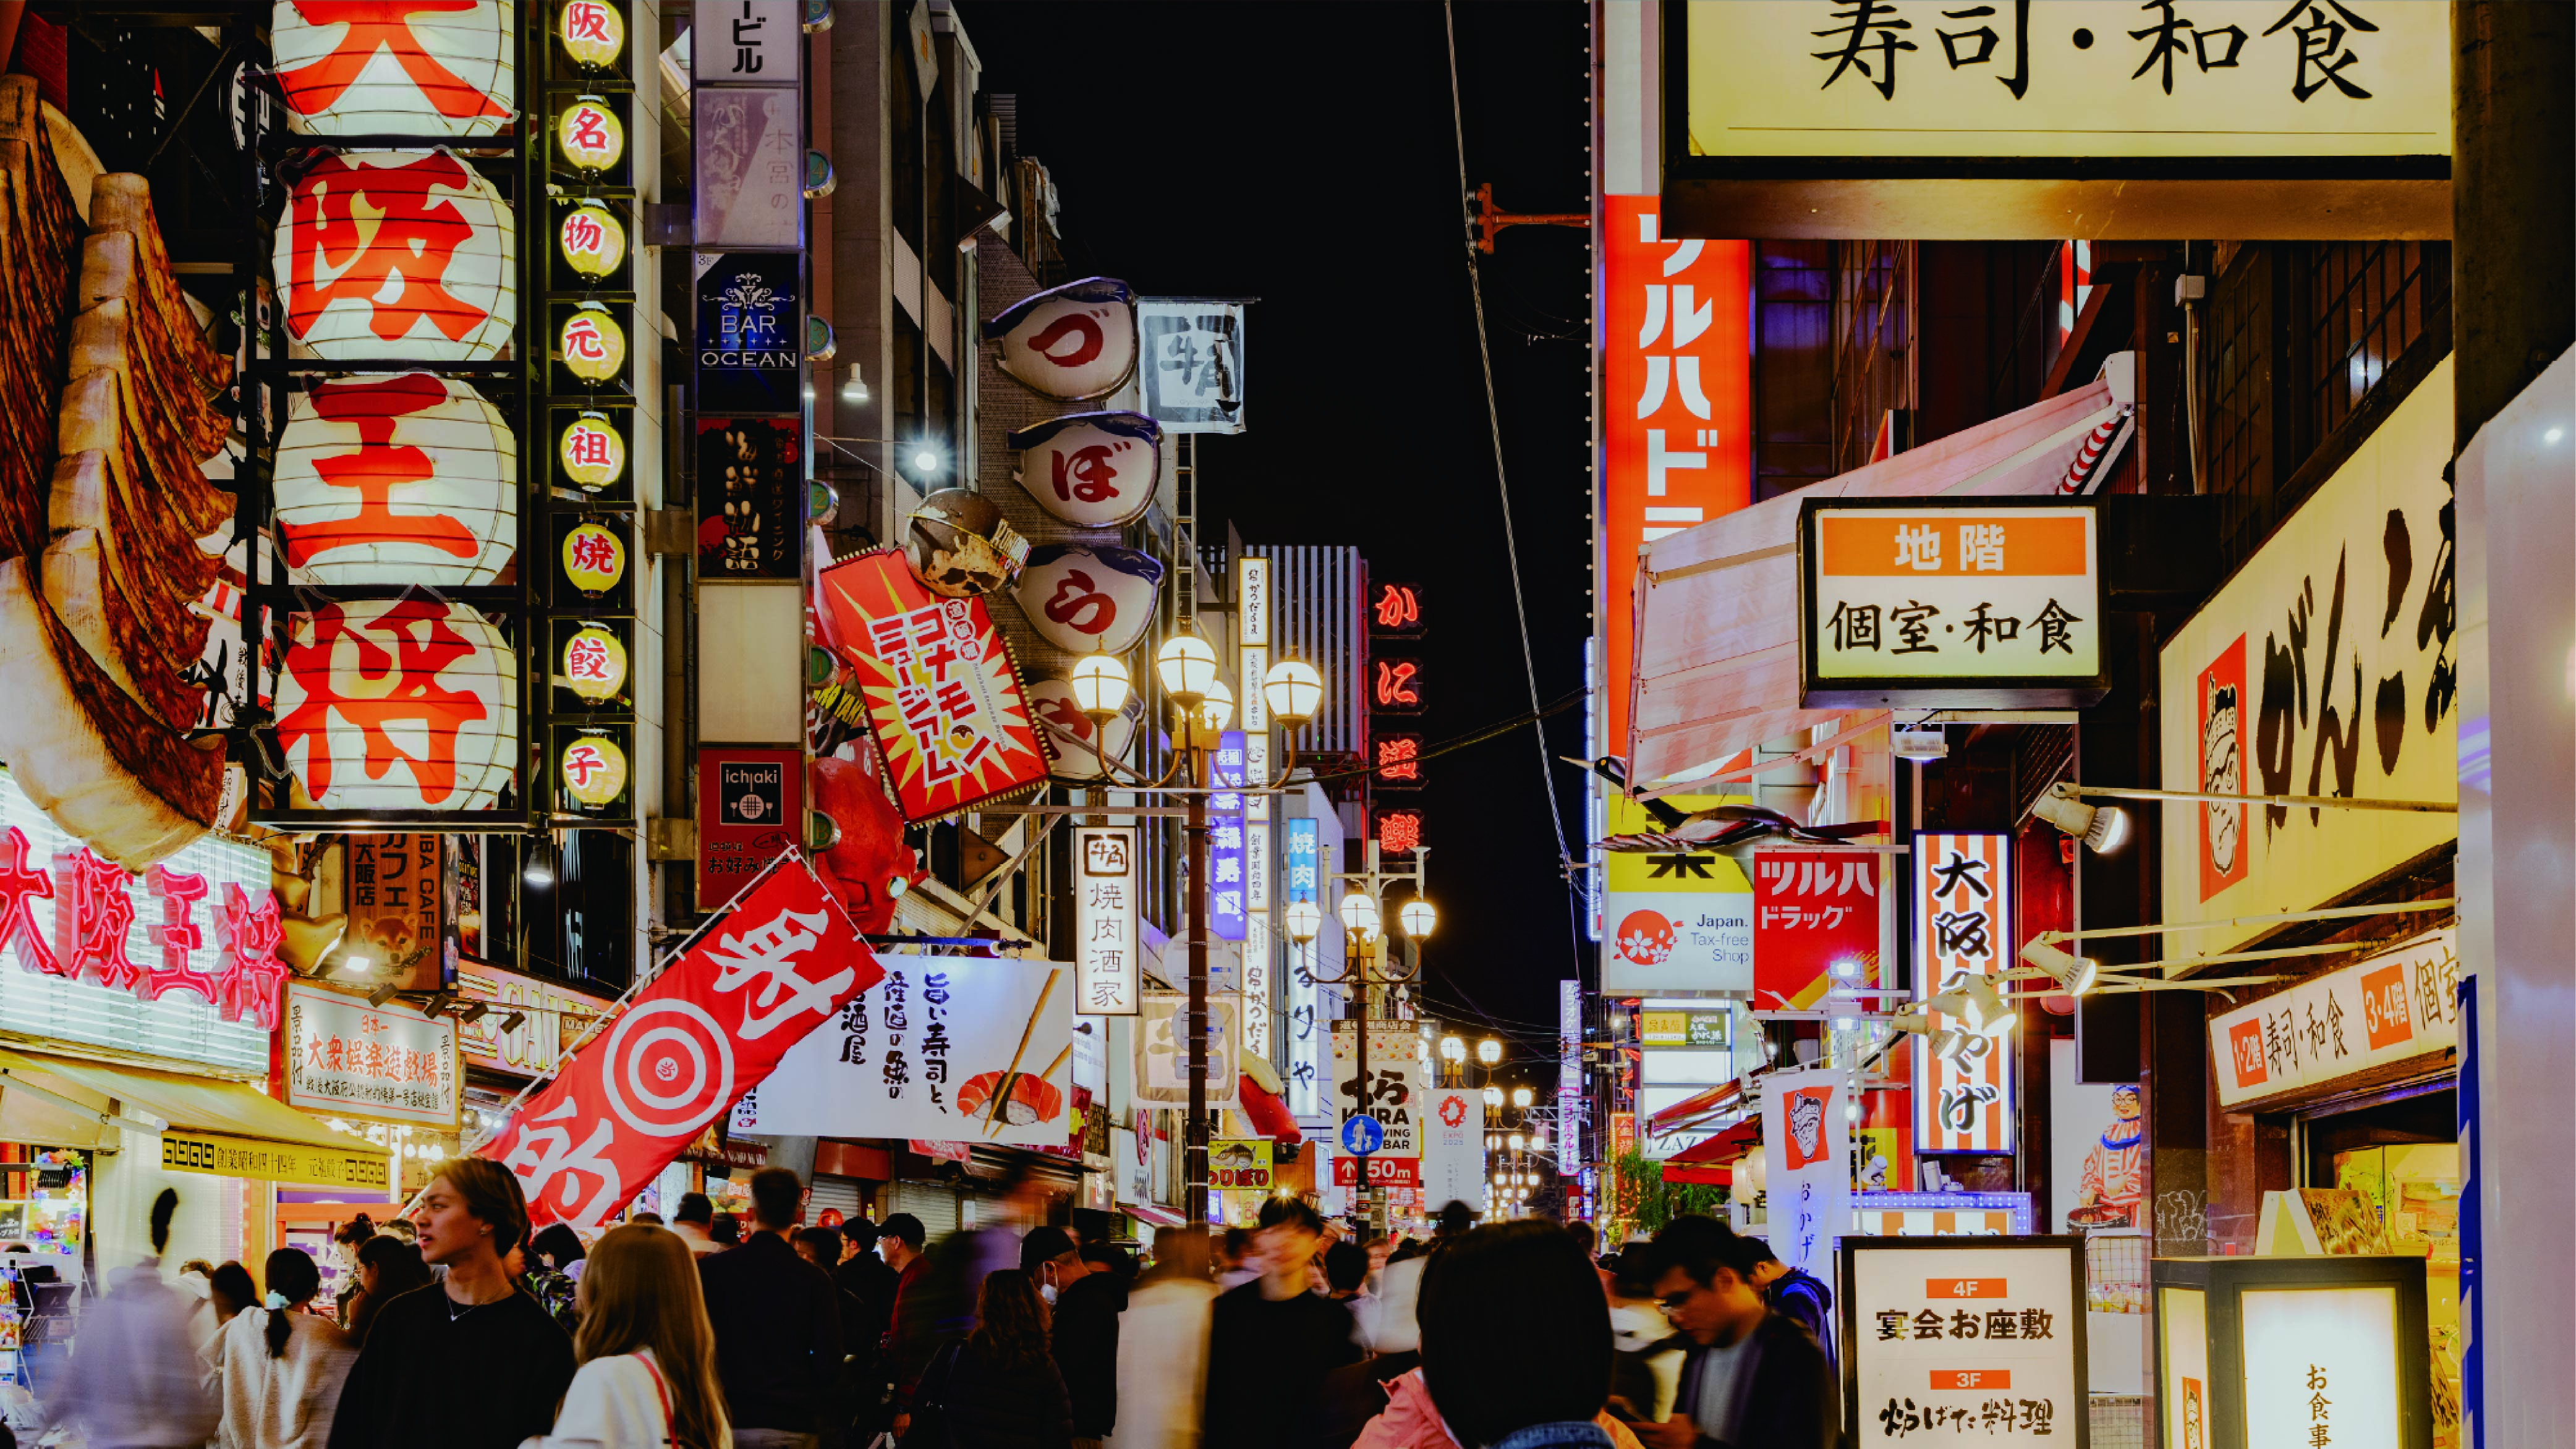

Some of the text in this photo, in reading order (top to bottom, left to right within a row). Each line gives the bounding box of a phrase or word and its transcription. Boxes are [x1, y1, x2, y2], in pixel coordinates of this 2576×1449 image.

[1809, 0, 2379, 103] 寿司・和食
[812, 161, 825, 179] 4
[698, 254, 713, 265] 3F
[721, 315, 775, 334] BAR
[813, 326, 825, 346] 3
[702, 352, 796, 367] OCEAN
[814, 491, 829, 510] 2
[1894, 524, 2005, 571] 地階
[1826, 599, 2083, 654] 個室・和食
[816, 656, 823, 676] 1
[816, 822, 829, 840] B
[1090, 843, 1124, 867] 牛角
[1288, 831, 1315, 888] 焼肉
[355, 844, 375, 906] 大阪店
[1761, 861, 1874, 897] ツルハ
[419, 878, 435, 940] CAFE
[1761, 906, 1853, 930] ドラッグ
[0, 826, 289, 1031] 大阪王将
[1698, 914, 1749, 930] Japan.
[1090, 883, 1124, 1006] 焼肉酒家
[1691, 932, 1749, 946] Tax-free
[1712, 949, 1749, 964] Shop
[1934, 853, 1996, 1130] 大阪やげ
[362, 1014, 389, 1037] 日本一
[2266, 987, 2349, 1077] 寿司・和食
[921, 972, 951, 1114] 旨い寿司と、
[308, 1032, 438, 1088] 大衆娯楽遊戯場
[1382, 1141, 1410, 1150] BAR
[1953, 1281, 1978, 1296] 4F
[1876, 1307, 2054, 1342] 宴会お座敷
[1956, 1372, 1981, 1388] 3F
[2306, 1363, 2333, 1449] お食事
